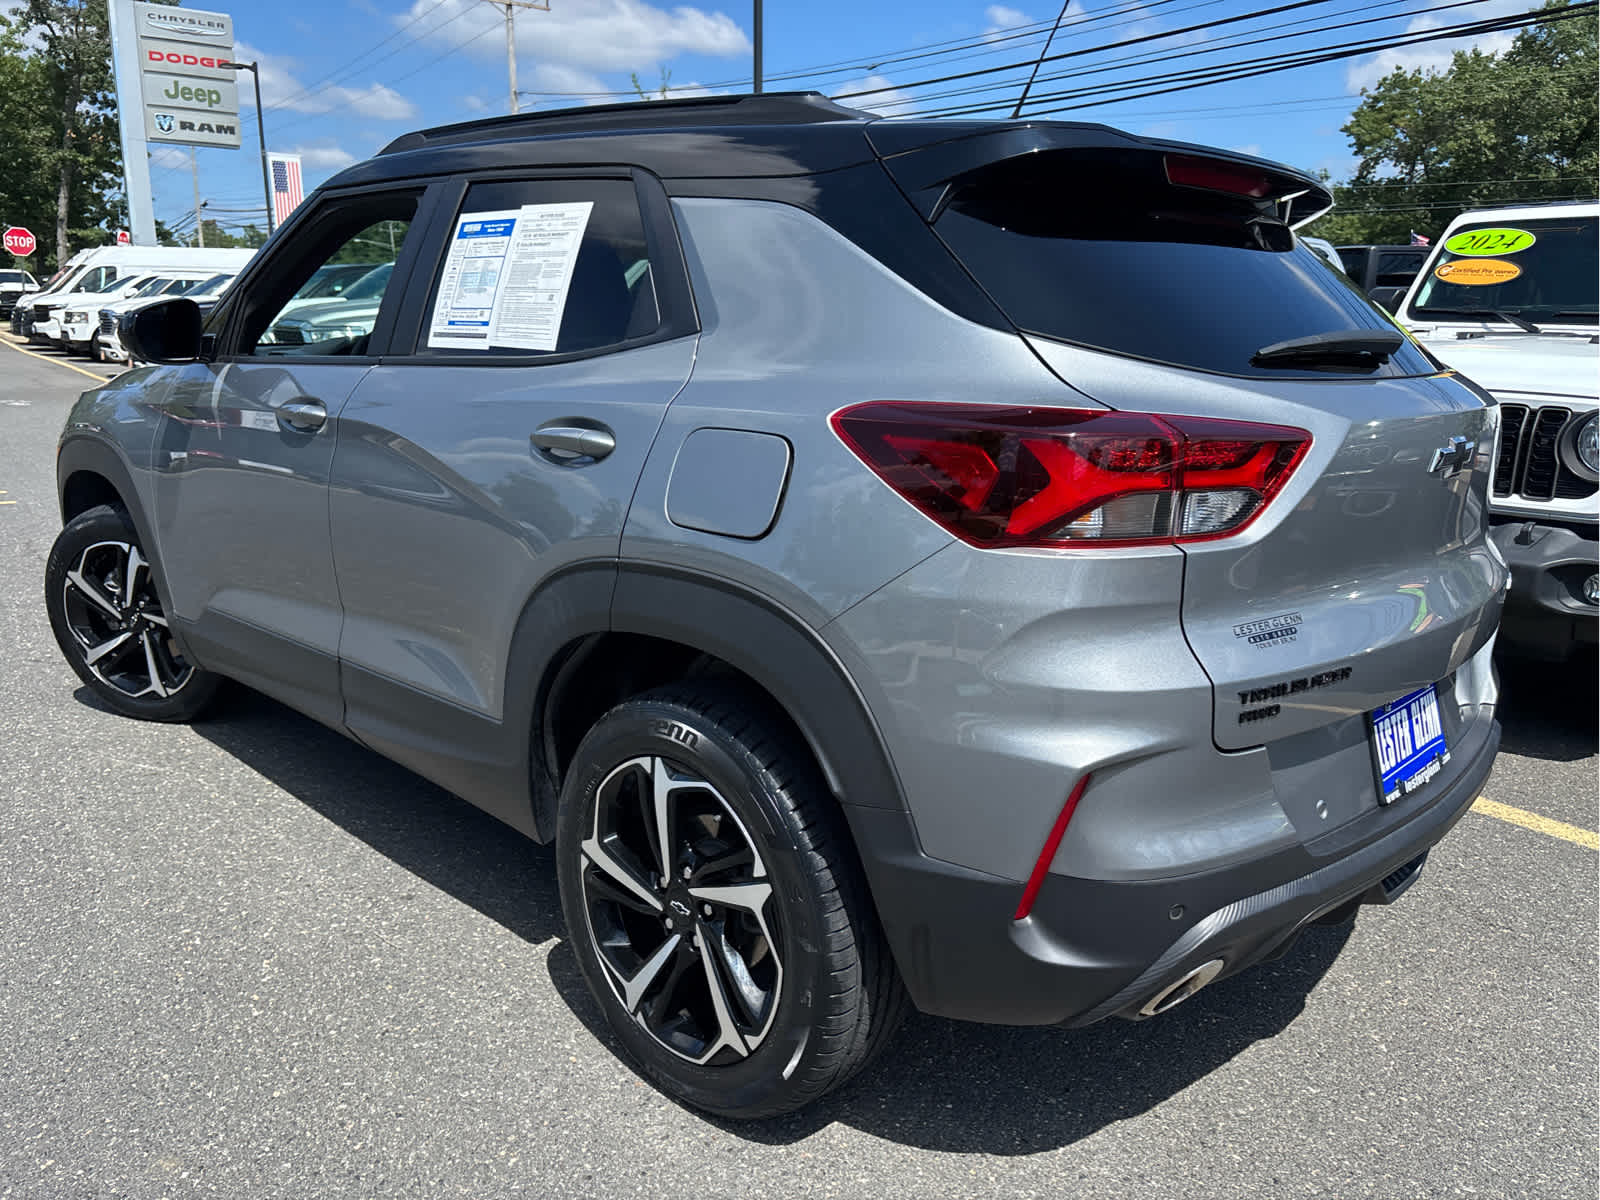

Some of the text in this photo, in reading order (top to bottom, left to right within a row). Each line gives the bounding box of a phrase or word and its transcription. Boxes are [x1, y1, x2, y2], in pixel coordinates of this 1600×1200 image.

[147, 12, 225, 30] CHRYSLER
[164, 80, 222, 108] Jeep
[179, 120, 236, 135] RAM
[6, 235, 33, 248] STOP
[1456, 234, 1524, 250] 2024
[1233, 614, 1303, 636] LESTER GLENN
[1238, 666, 1353, 705] TRAILBLAZER
[1374, 690, 1442, 774] LESTER GLENN
